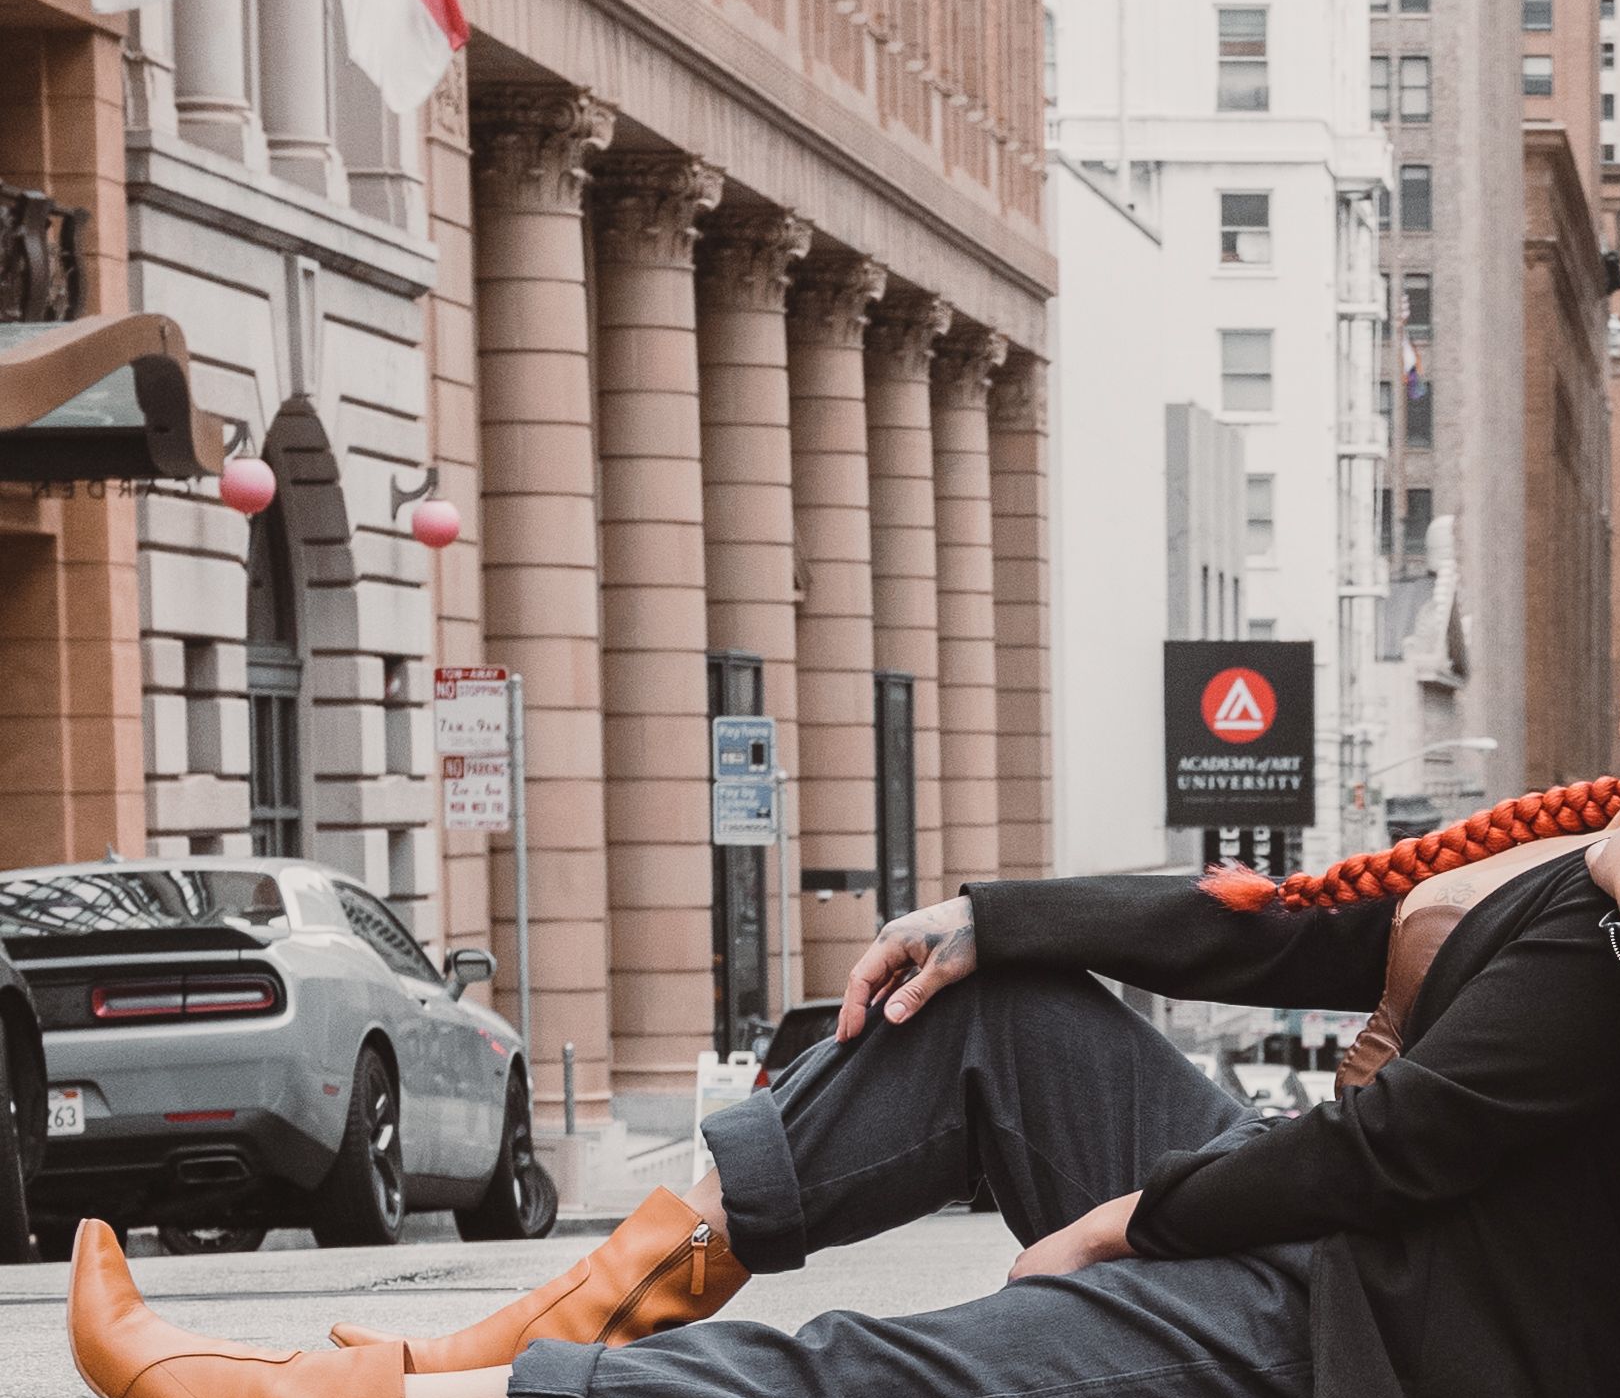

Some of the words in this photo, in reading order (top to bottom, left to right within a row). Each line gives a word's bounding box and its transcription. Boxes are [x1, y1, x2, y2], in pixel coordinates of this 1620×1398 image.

[436, 682, 455, 698] NO
[465, 762, 505, 777] PARKING
[1178, 755, 1257, 771] ACADEMY
[1270, 755, 1301, 771] ART
[1177, 774, 1301, 790] UNIVERSITY
